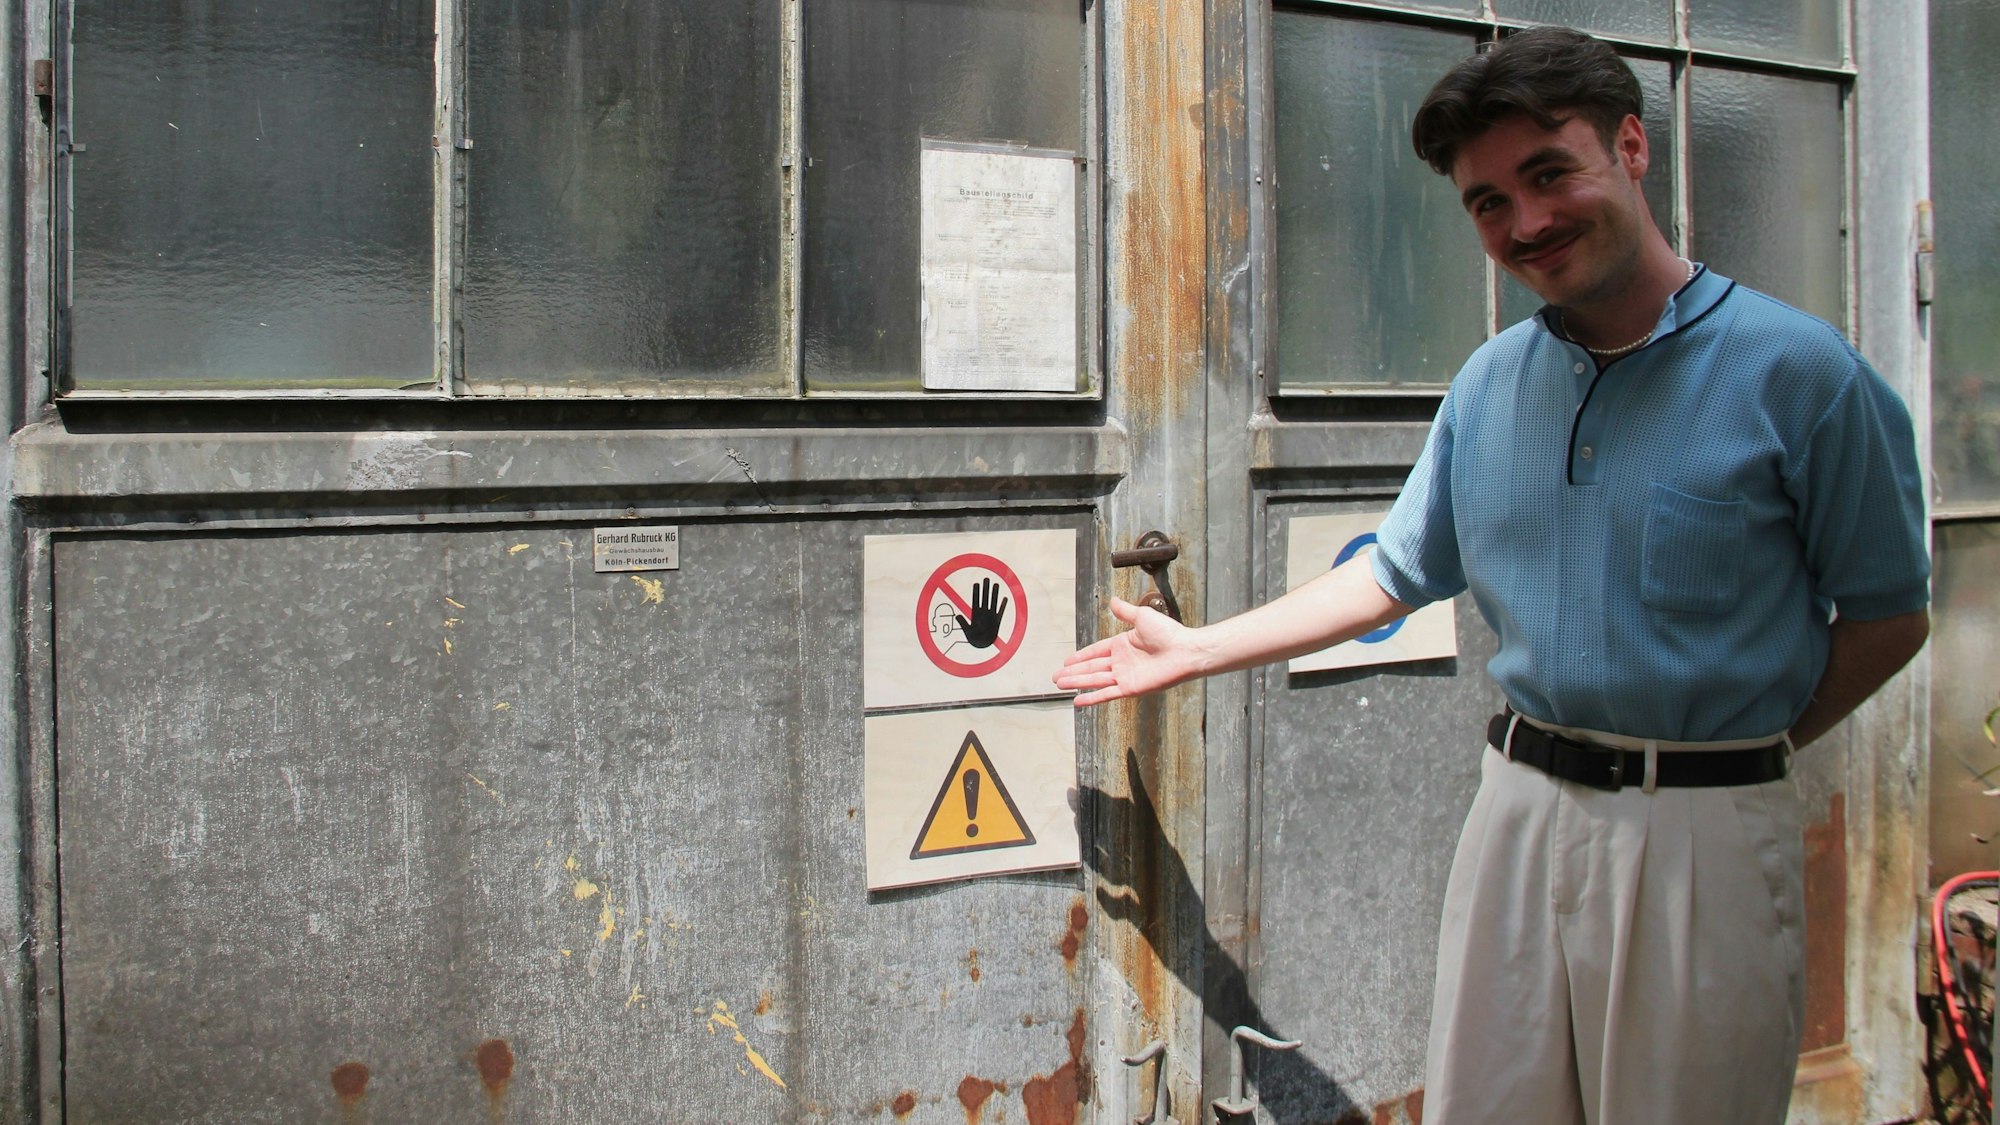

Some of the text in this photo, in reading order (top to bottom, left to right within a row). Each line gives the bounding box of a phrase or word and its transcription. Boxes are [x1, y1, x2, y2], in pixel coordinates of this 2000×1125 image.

[597, 532, 676, 543] Gerhard Rubruck KG
